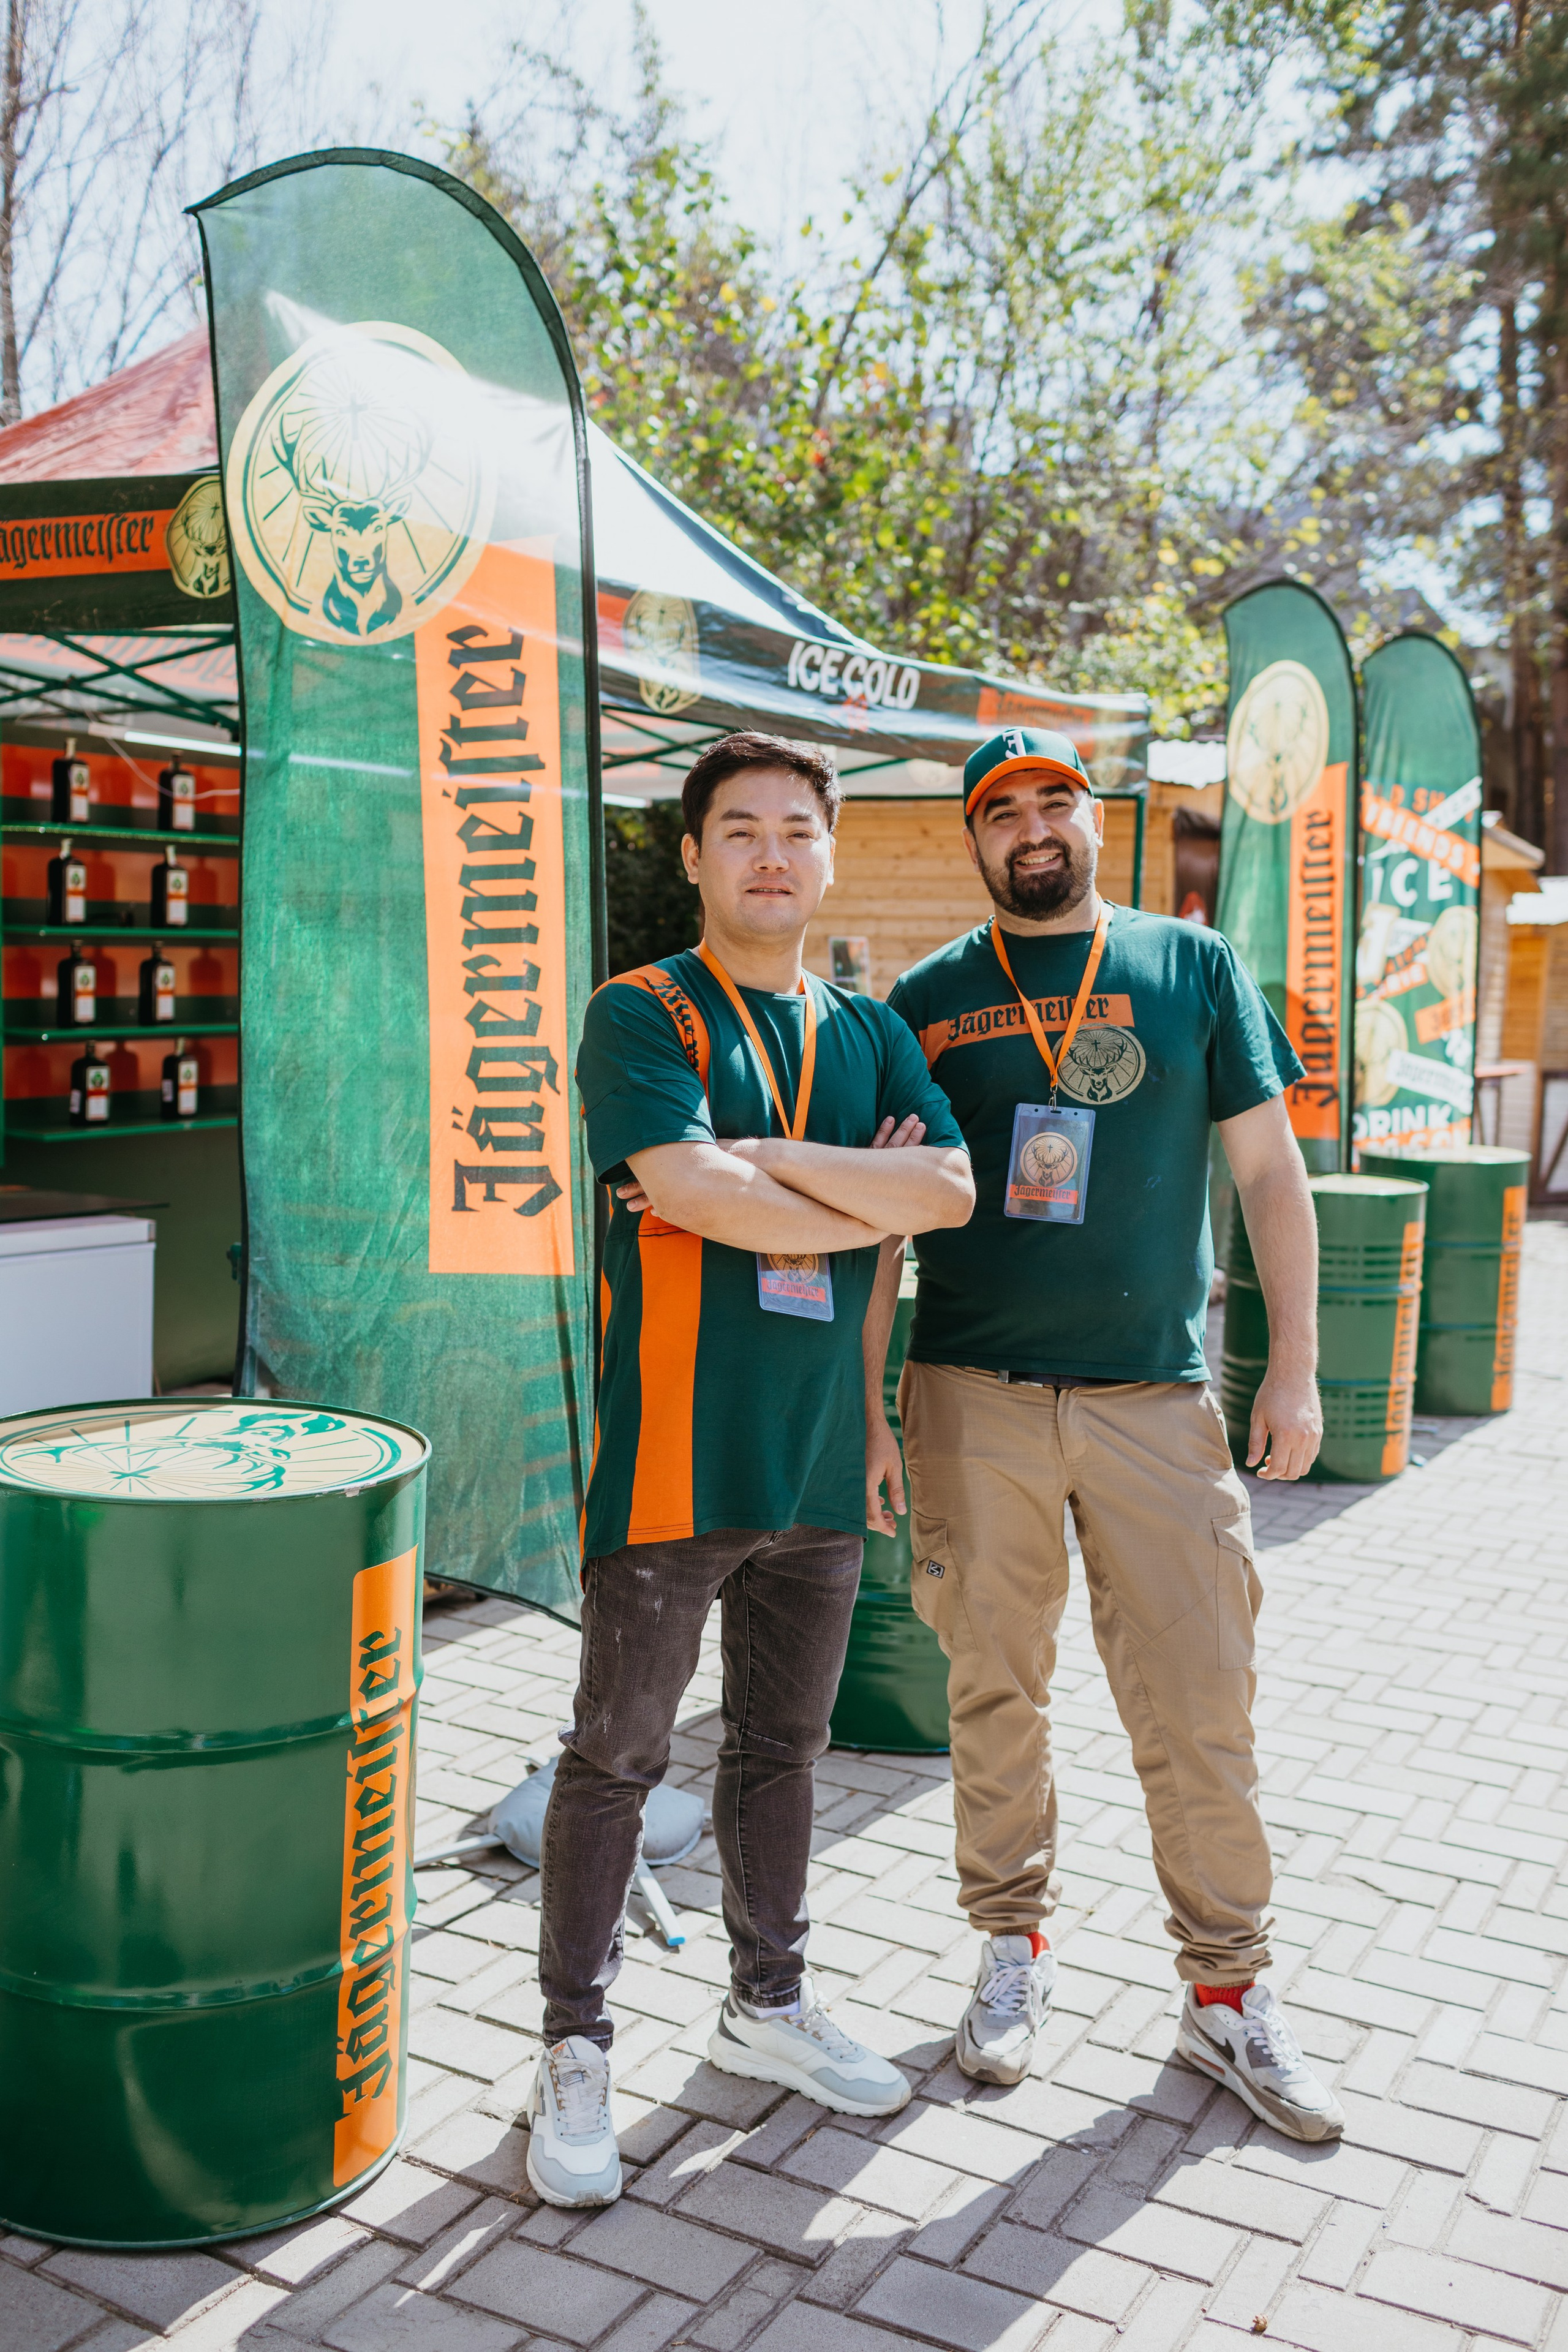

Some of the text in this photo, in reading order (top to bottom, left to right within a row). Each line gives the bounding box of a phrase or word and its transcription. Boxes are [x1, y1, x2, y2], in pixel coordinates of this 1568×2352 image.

[0, 512, 154, 570] ägermeister
[788, 640, 845, 695] ICE
[842, 655, 921, 710] COLD
[1372, 858, 1453, 907] ICE
[439, 625, 563, 1217] Jägermeister
[948, 995, 1109, 1042] Jägermeiser
[336, 1627, 405, 2118] Jägermeister
